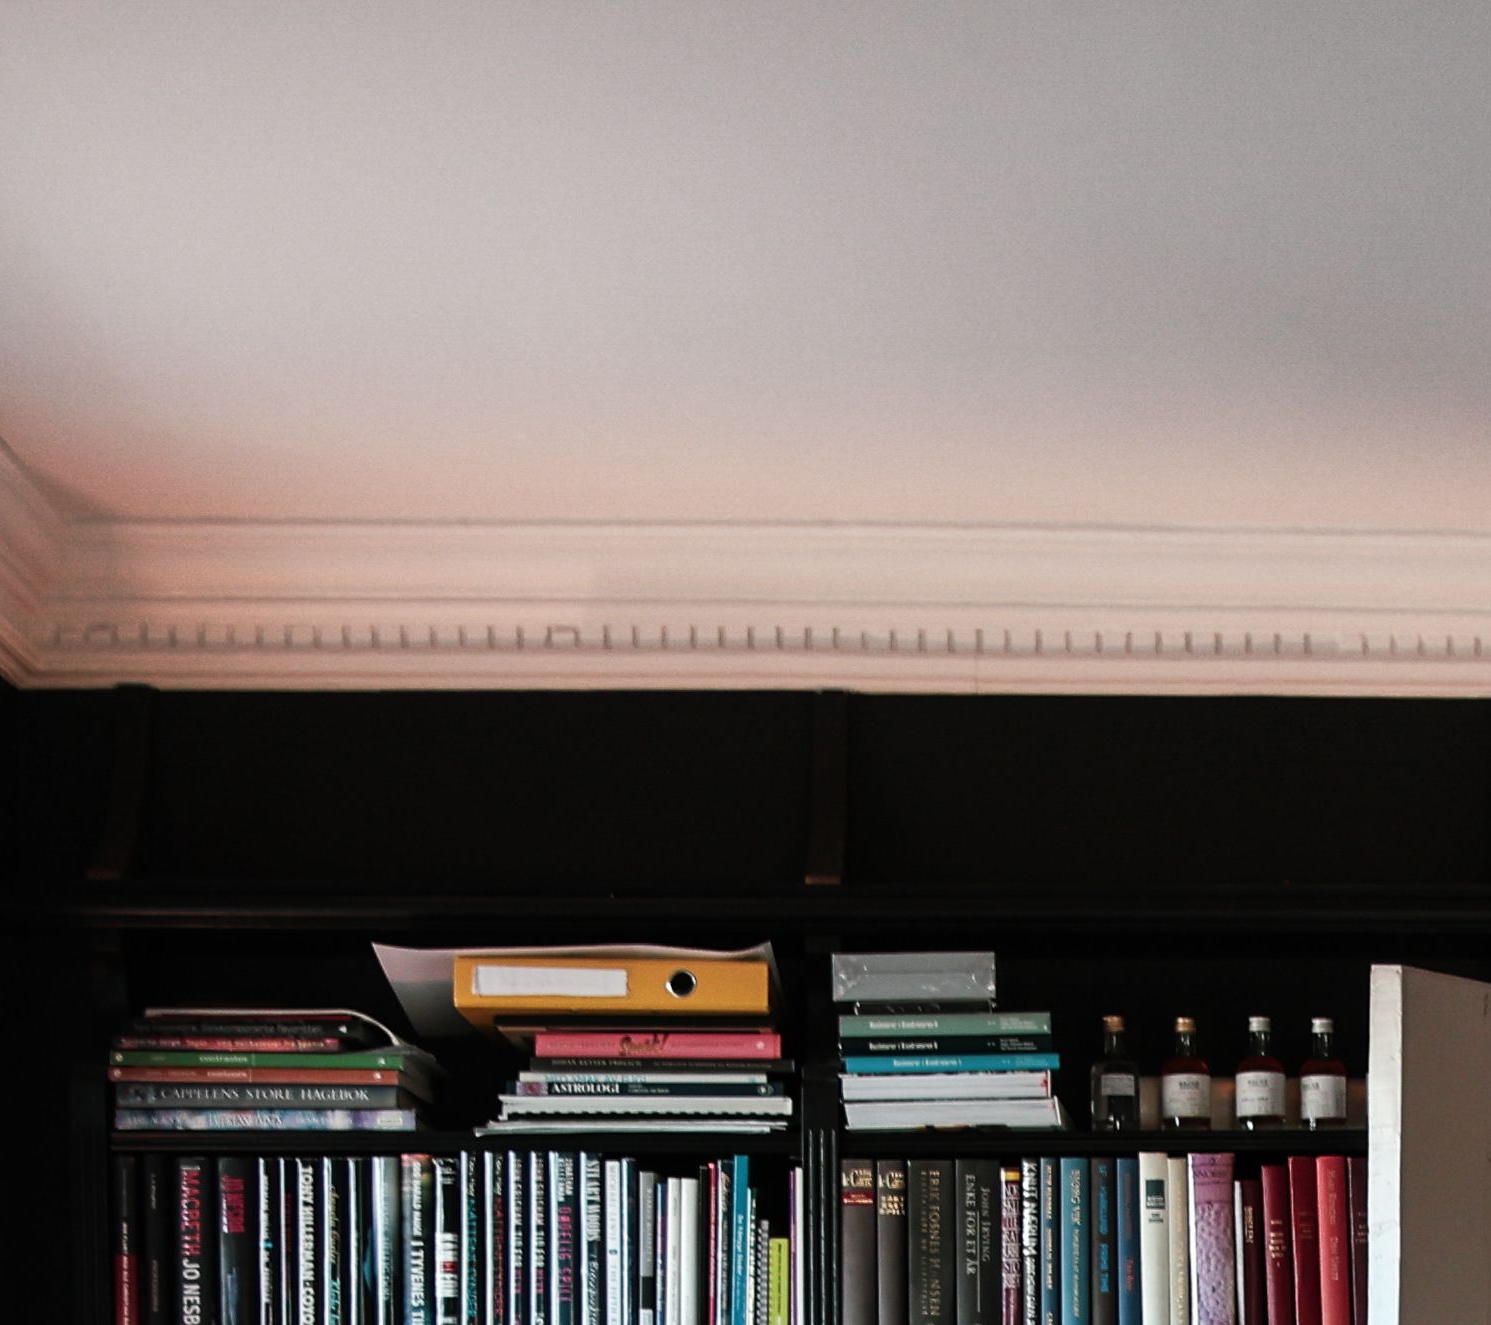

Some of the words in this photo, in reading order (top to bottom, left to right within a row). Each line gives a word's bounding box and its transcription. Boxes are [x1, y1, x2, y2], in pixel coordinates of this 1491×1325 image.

[160, 1089, 239, 1100] CAPPELENS
[246, 1089, 293, 1100] STORE
[301, 1089, 369, 1101] HAGEBOK
[552, 1082, 620, 1094] ASTROLOGI
[965, 1174, 976, 1207] ENKE
[965, 1211, 976, 1236] FOR
[965, 1240, 976, 1253] ET
[182, 1258, 200, 1279] JO
